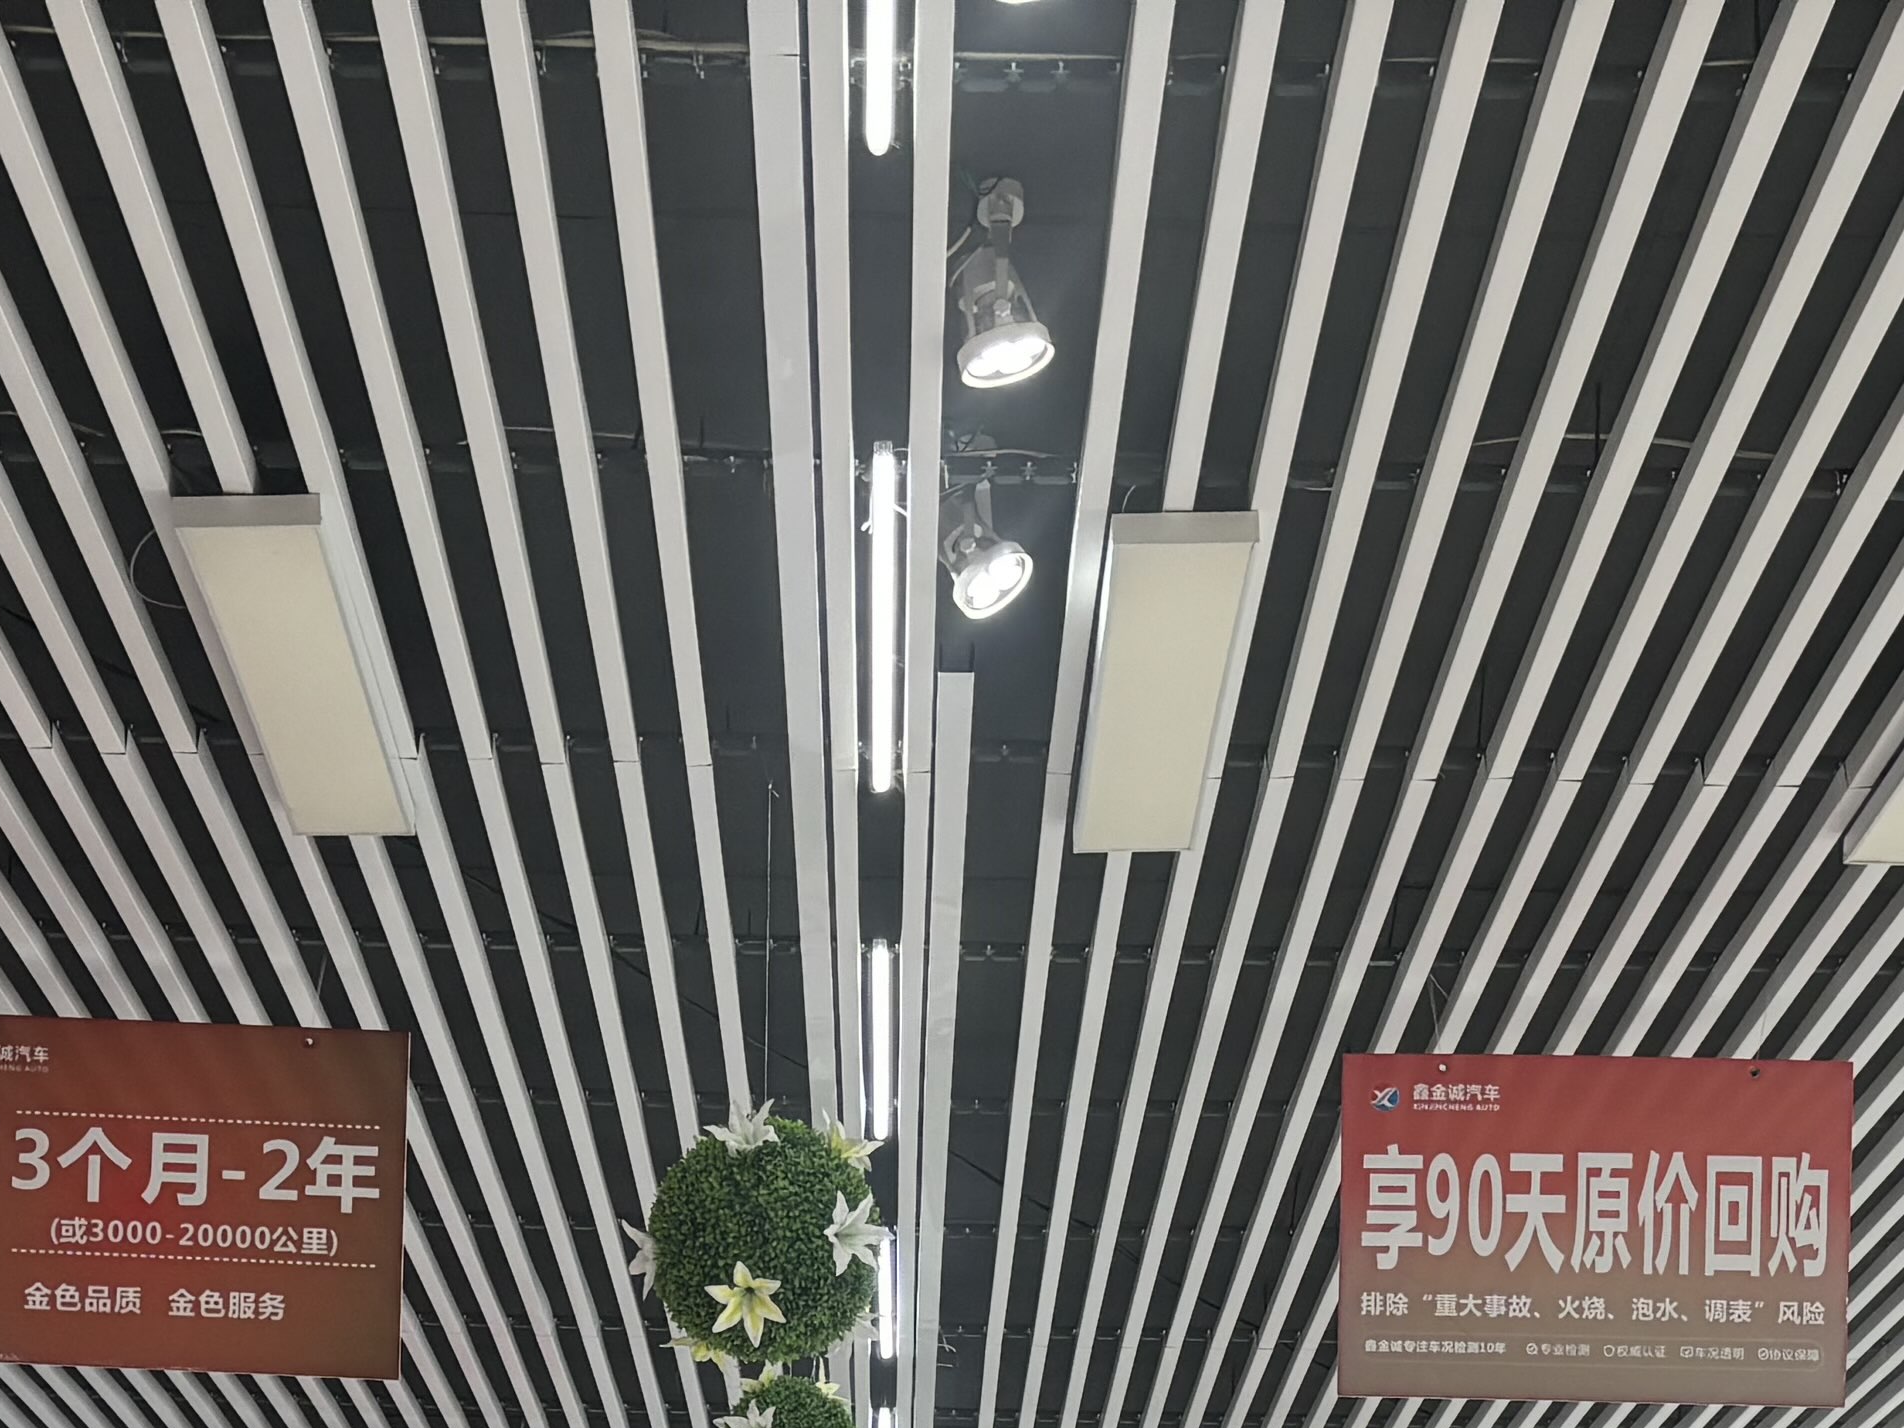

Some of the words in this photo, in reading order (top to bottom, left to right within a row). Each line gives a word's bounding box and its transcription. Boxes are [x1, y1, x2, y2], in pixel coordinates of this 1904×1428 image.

[11, 1126, 381, 1214] 3个月-2年
[1360, 1143, 1830, 1278] 享90天原价回购
[24, 1281, 142, 1316] 金色品质
[168, 1287, 286, 1321] 金色服务
